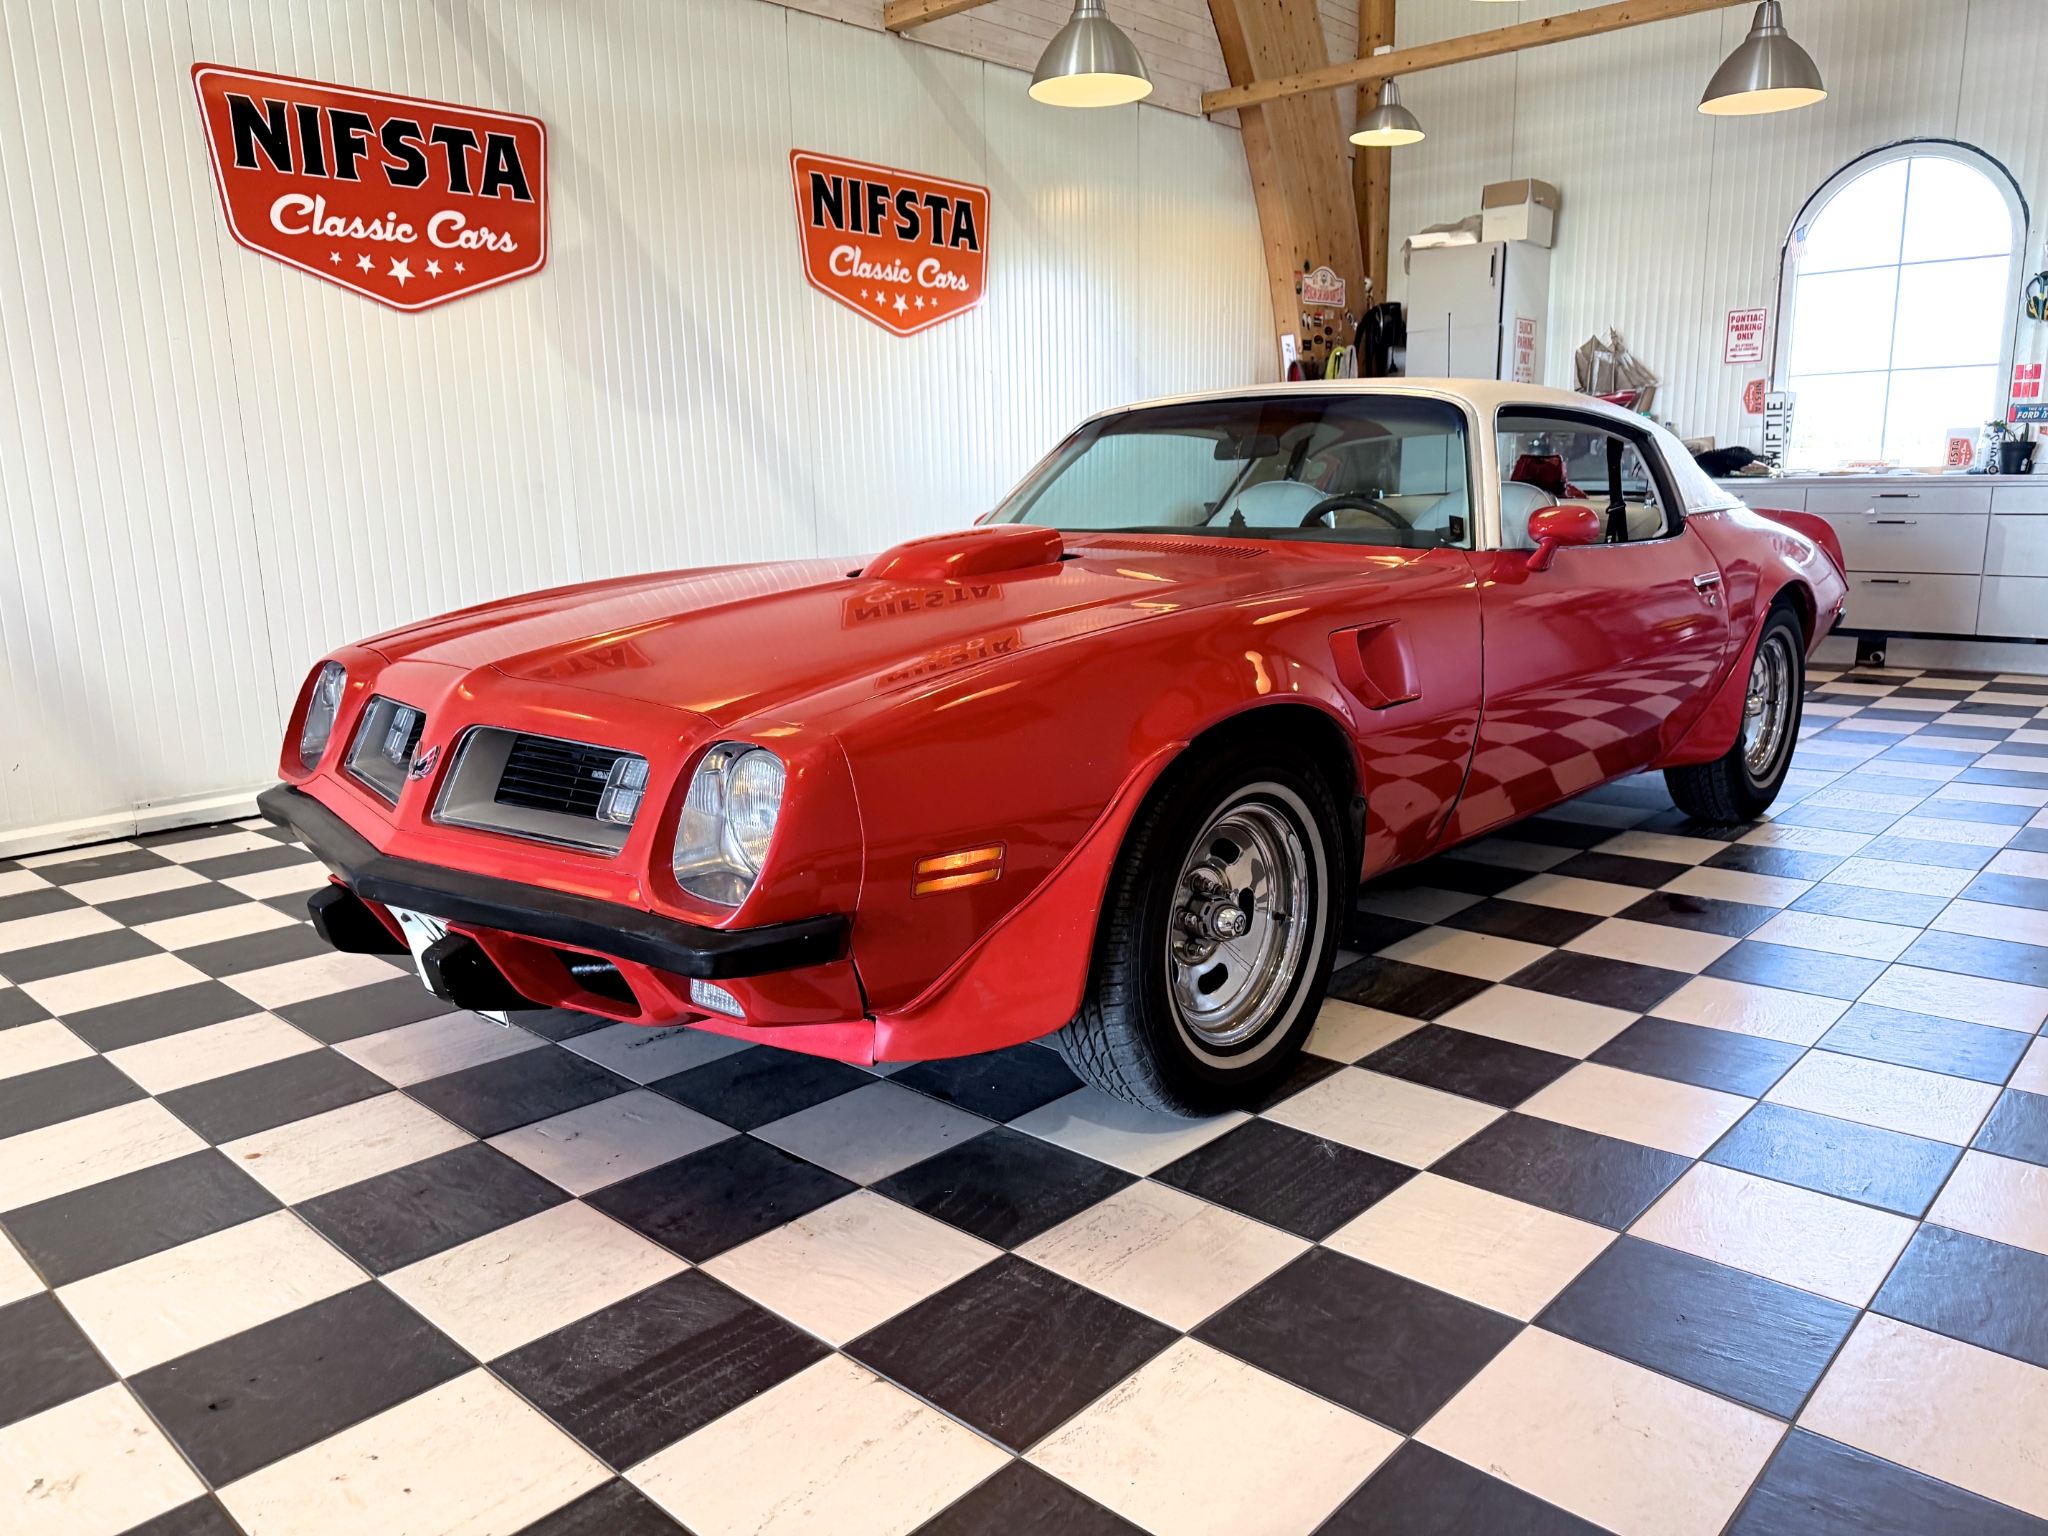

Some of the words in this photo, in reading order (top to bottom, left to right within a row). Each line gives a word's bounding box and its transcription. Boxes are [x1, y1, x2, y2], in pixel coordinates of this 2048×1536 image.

[224, 92, 535, 203] NIFSTA
[269, 193, 418, 244] Classic
[427, 210, 518, 253] Cars
[808, 170, 981, 253] NIFSTA
[829, 245, 912, 283] Classic
[917, 258, 969, 291] Cars
[1731, 314, 1763, 323] PONTIAC
[1731, 323, 1762, 332] PARKING
[1737, 332, 1754, 340] ONLY
[2016, 411, 2040, 419] FORD
[1949, 440, 1960, 466] IFSTA
